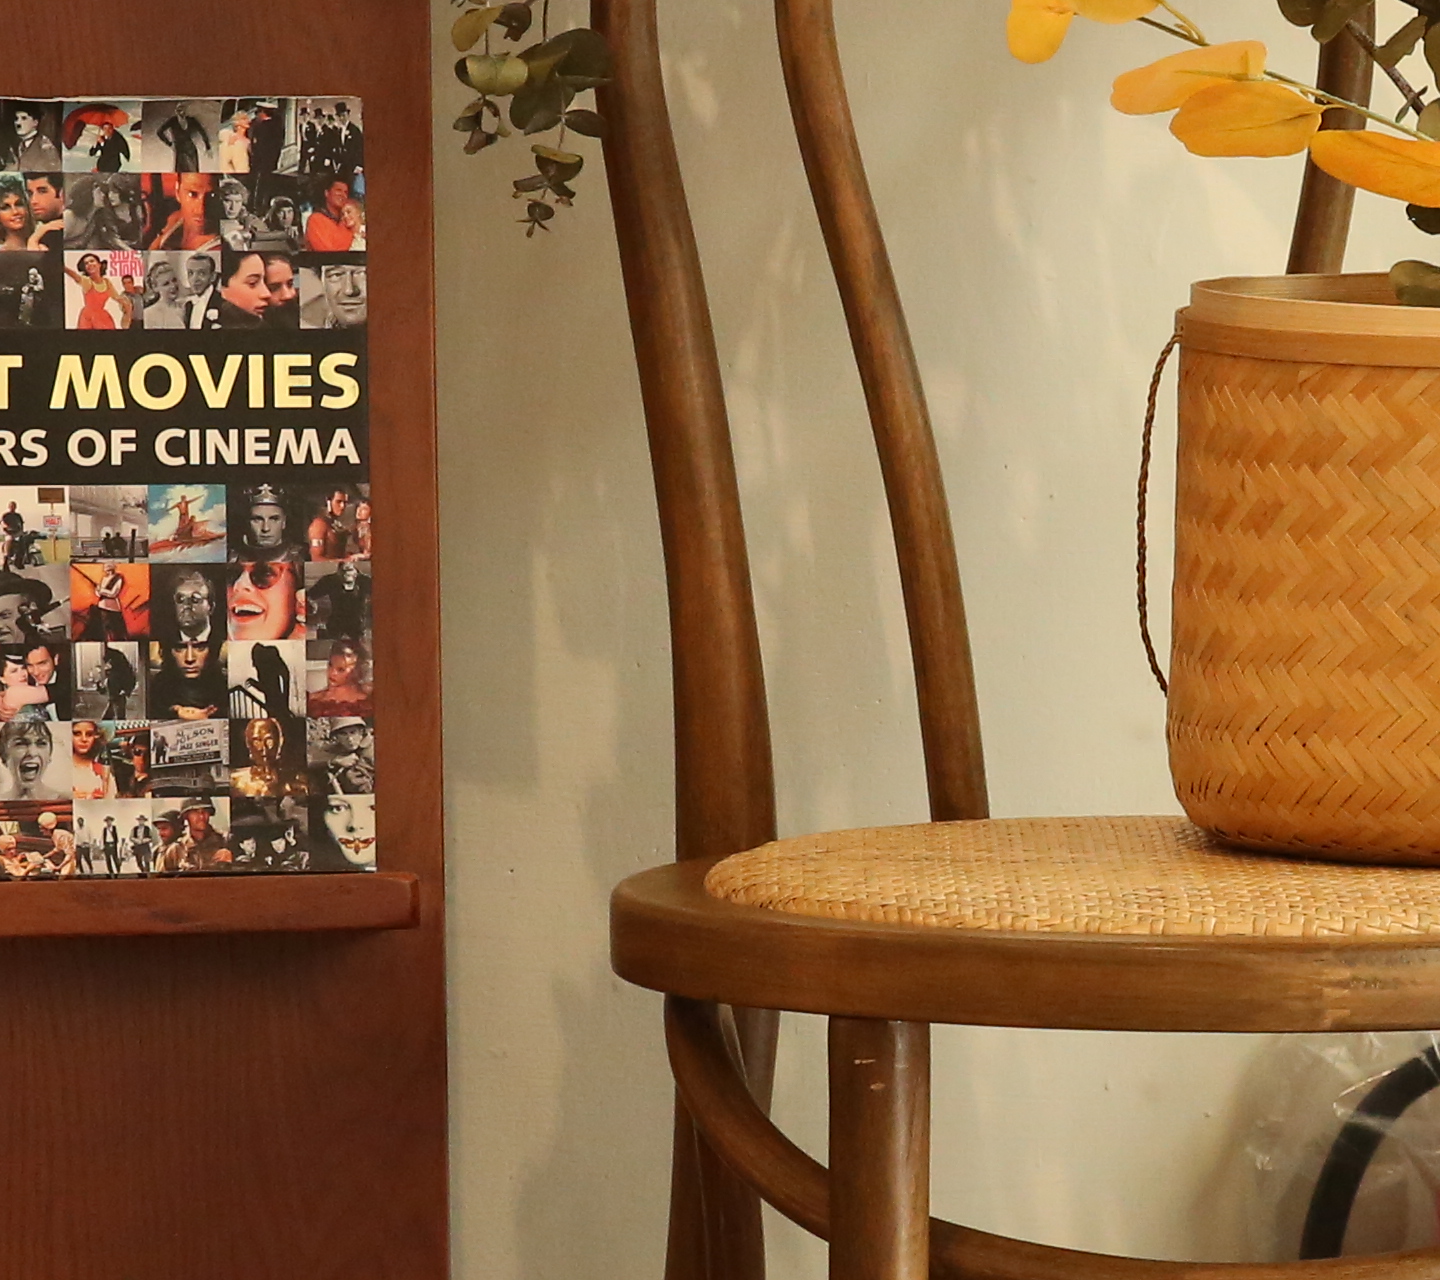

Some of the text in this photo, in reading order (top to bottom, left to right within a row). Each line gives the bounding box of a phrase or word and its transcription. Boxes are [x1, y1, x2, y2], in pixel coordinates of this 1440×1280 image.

[49, 352, 361, 410] MOVIES
[67, 428, 138, 466] OF
[154, 428, 361, 466] CINEMA
